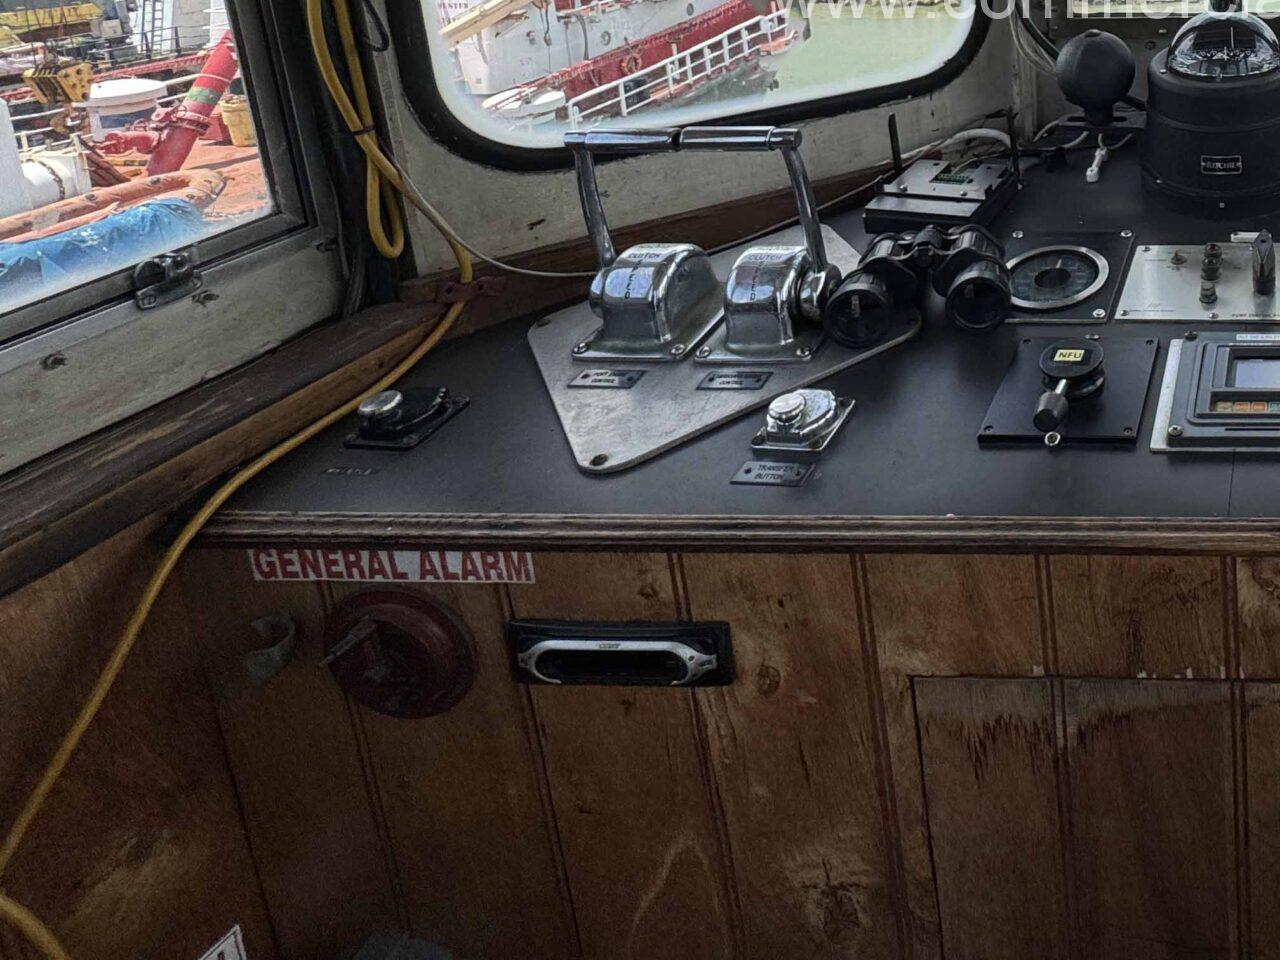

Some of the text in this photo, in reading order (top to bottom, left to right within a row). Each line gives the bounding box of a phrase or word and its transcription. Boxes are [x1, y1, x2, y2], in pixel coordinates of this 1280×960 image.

[1058, 351, 1083, 360] NFU
[757, 464, 794, 472] TRANSFER
[754, 473, 784, 481] BUTTON
[253, 550, 531, 580] GENERAL ALARM
